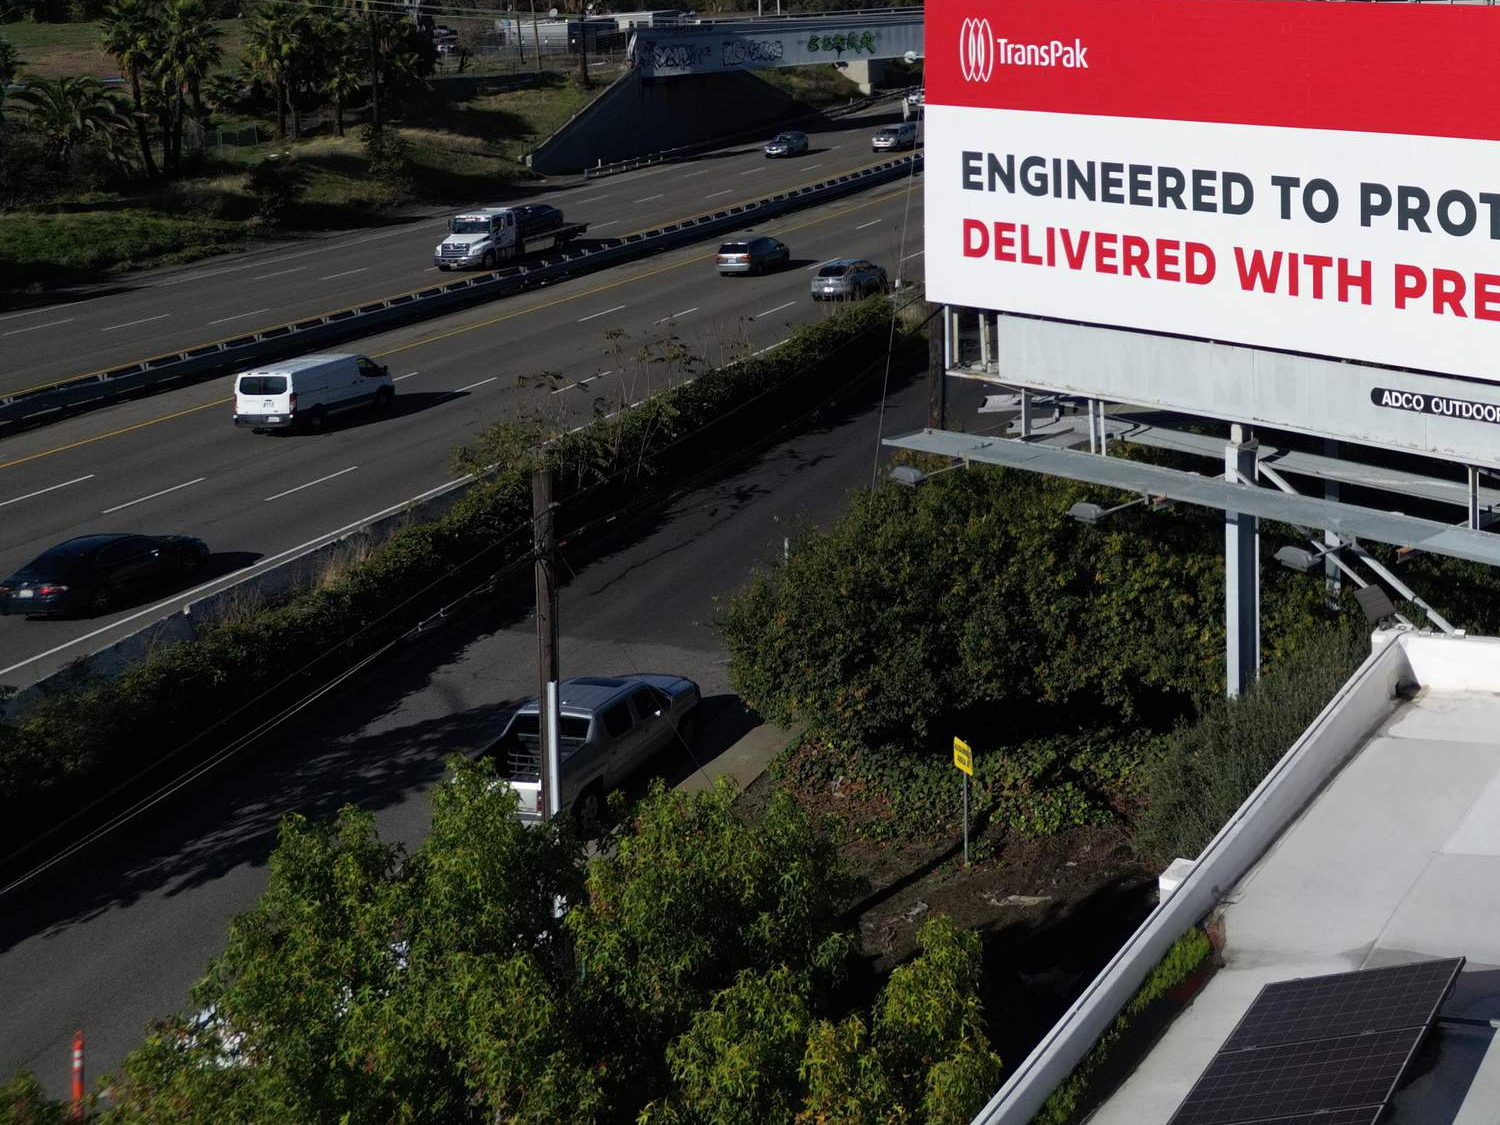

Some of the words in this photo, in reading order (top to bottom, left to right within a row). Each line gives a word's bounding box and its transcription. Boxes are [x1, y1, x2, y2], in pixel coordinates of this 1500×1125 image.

[996, 38, 1089, 69] TransPak
[961, 150, 1254, 216] ENGINEERED
[1270, 175, 1339, 224] TO
[963, 218, 1217, 286] DELIVERED
[1233, 246, 1372, 306] WITH
[1381, 390, 1425, 411] ADCO
